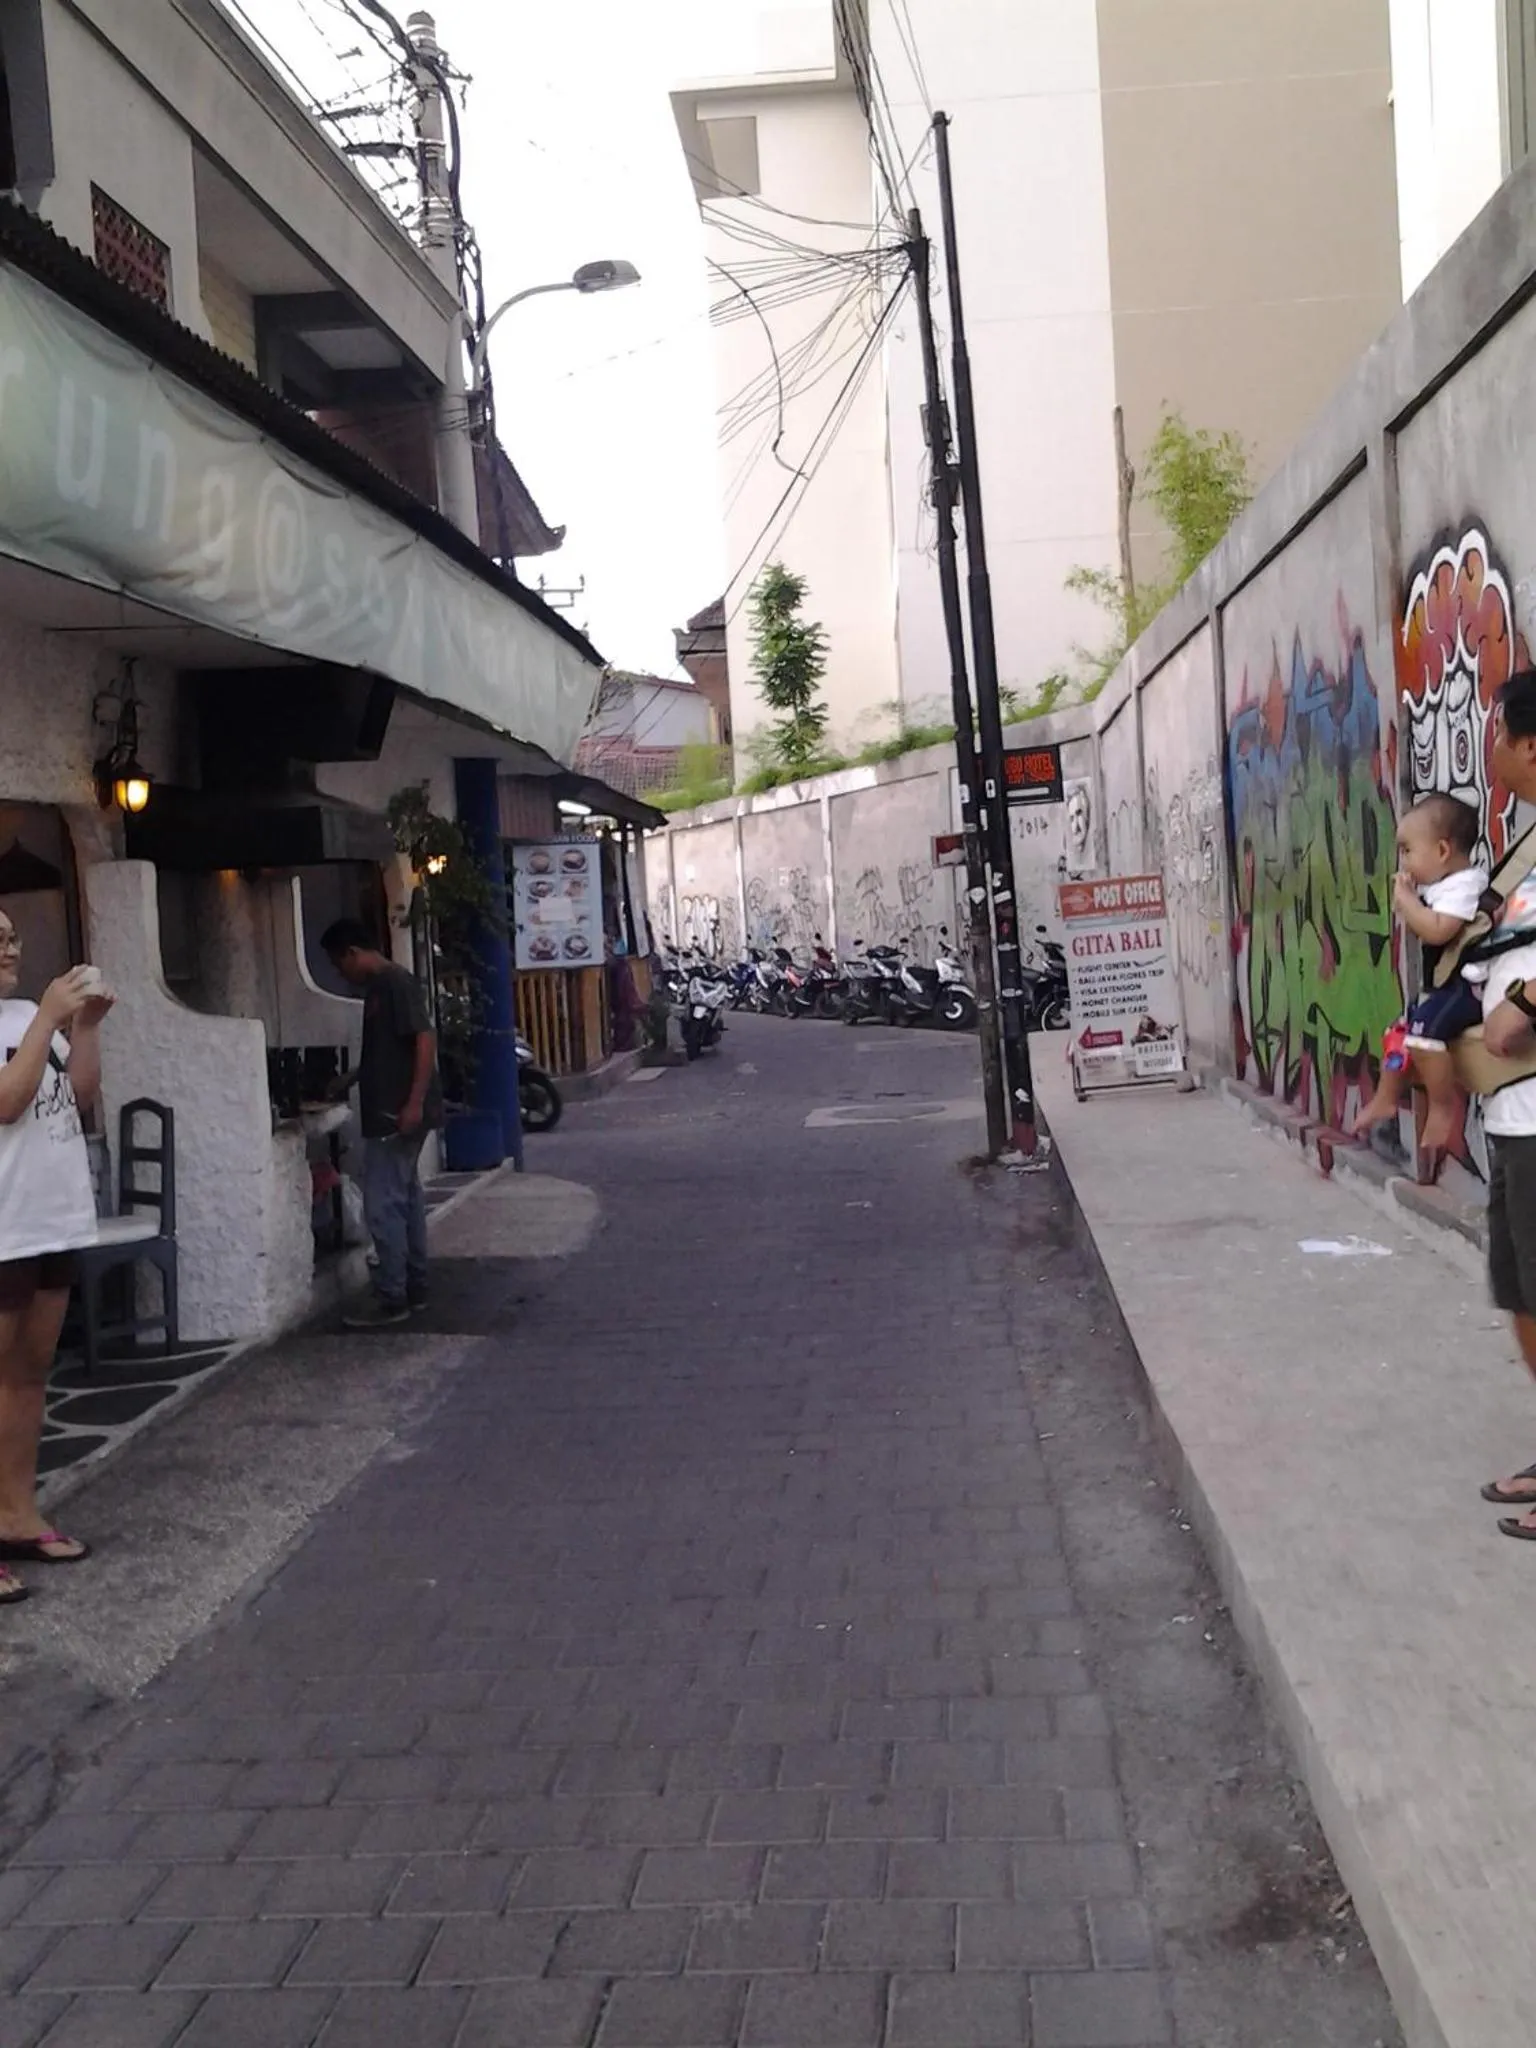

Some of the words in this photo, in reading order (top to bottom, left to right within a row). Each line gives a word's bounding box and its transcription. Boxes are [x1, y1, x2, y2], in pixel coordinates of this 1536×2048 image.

[1092, 884, 1122, 909] POST
[1123, 879, 1162, 905] OFFICE
[1072, 932, 1116, 958] GITA
[1121, 927, 1163, 952] BALI
[1080, 987, 1098, 997] VISA
[1099, 984, 1142, 995] EXTENSION
[1081, 998, 1109, 1008] MONEY
[1111, 994, 1148, 1005] CHANGER
[1128, 1005, 1149, 1015] CARD
